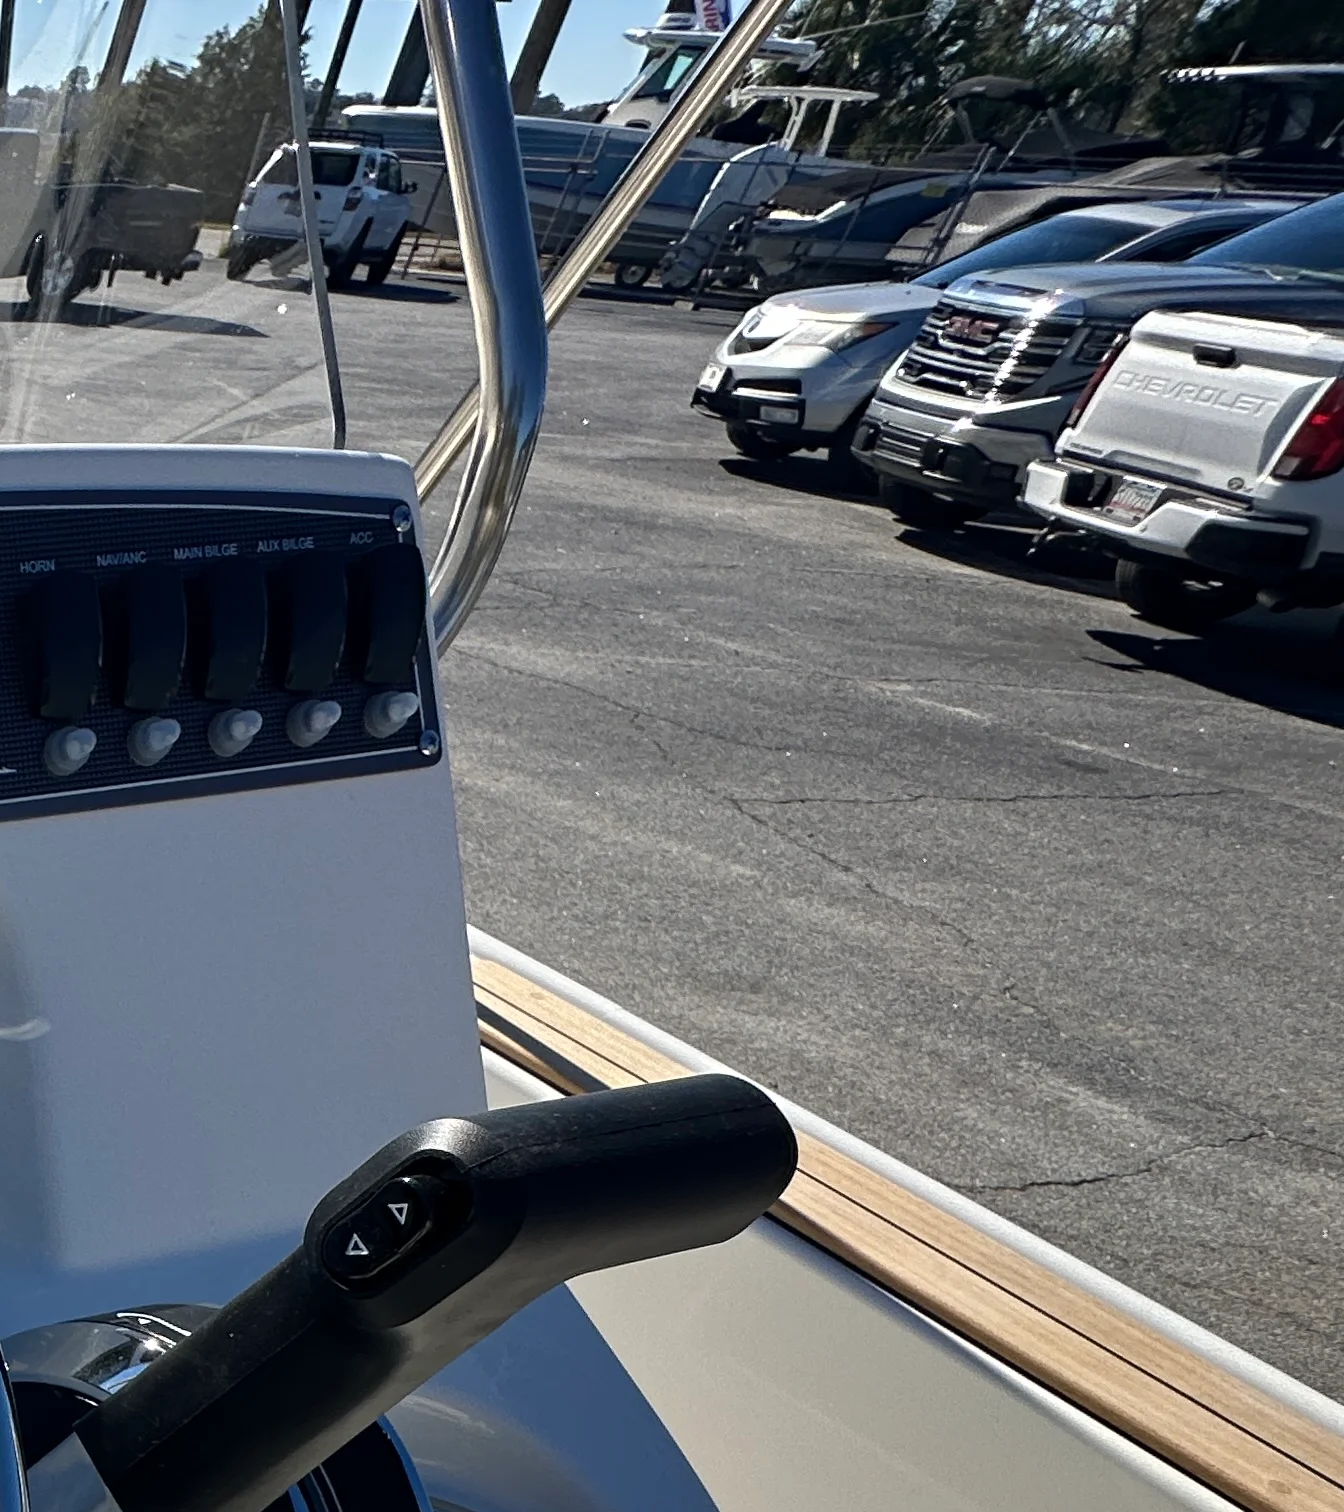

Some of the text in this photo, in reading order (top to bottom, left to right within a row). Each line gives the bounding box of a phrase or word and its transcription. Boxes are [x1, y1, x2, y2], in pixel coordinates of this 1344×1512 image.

[1114, 369, 1279, 417] CHEVROLET
[256, 536, 315, 553] AUX BILGE
[349, 531, 374, 545] ACC
[173, 544, 239, 560] MAIN BILGE
[19, 559, 56, 574] HORN
